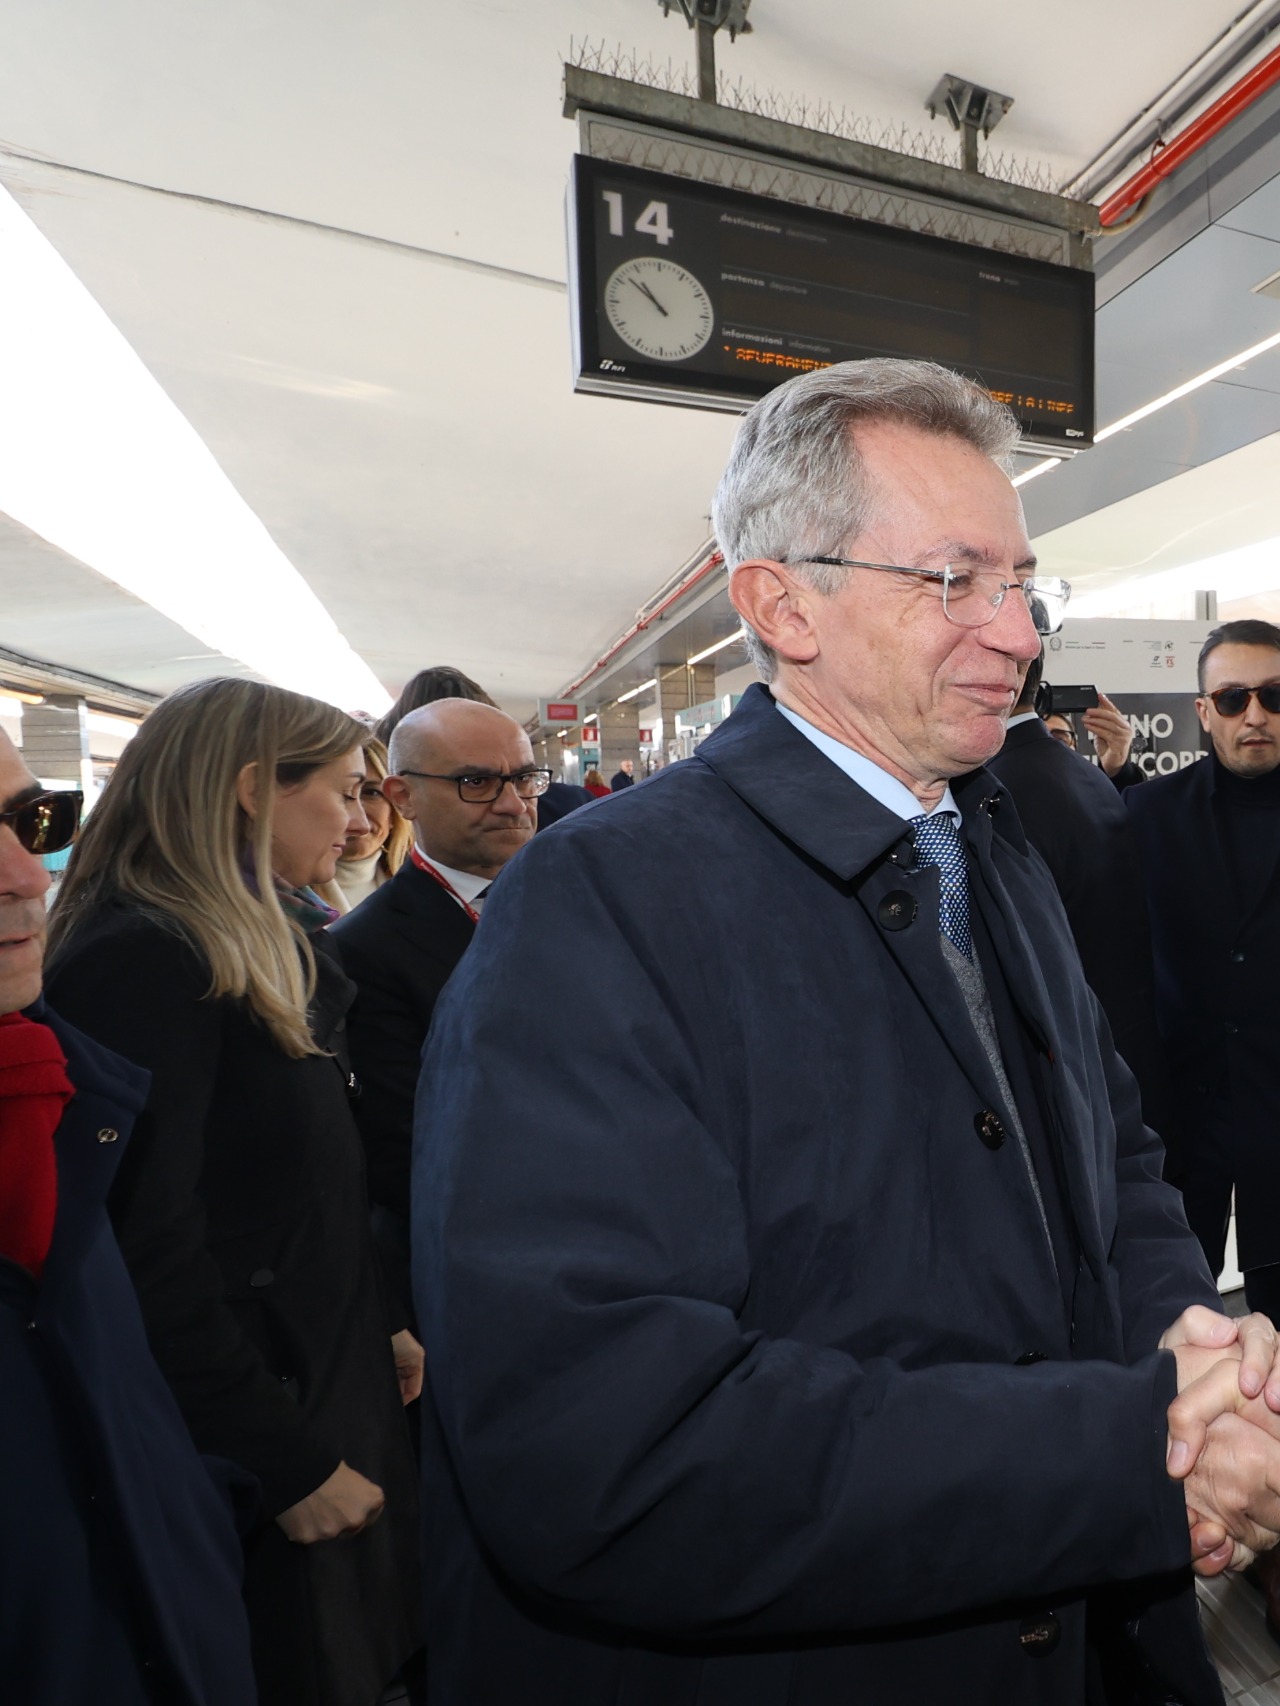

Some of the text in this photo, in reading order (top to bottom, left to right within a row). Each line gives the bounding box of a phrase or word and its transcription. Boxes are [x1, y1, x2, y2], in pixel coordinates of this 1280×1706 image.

[602, 190, 674, 246] 14
[720, 213, 781, 234] destinazione
[721, 271, 765, 288] partenza
[722, 328, 783, 346] informazioni
